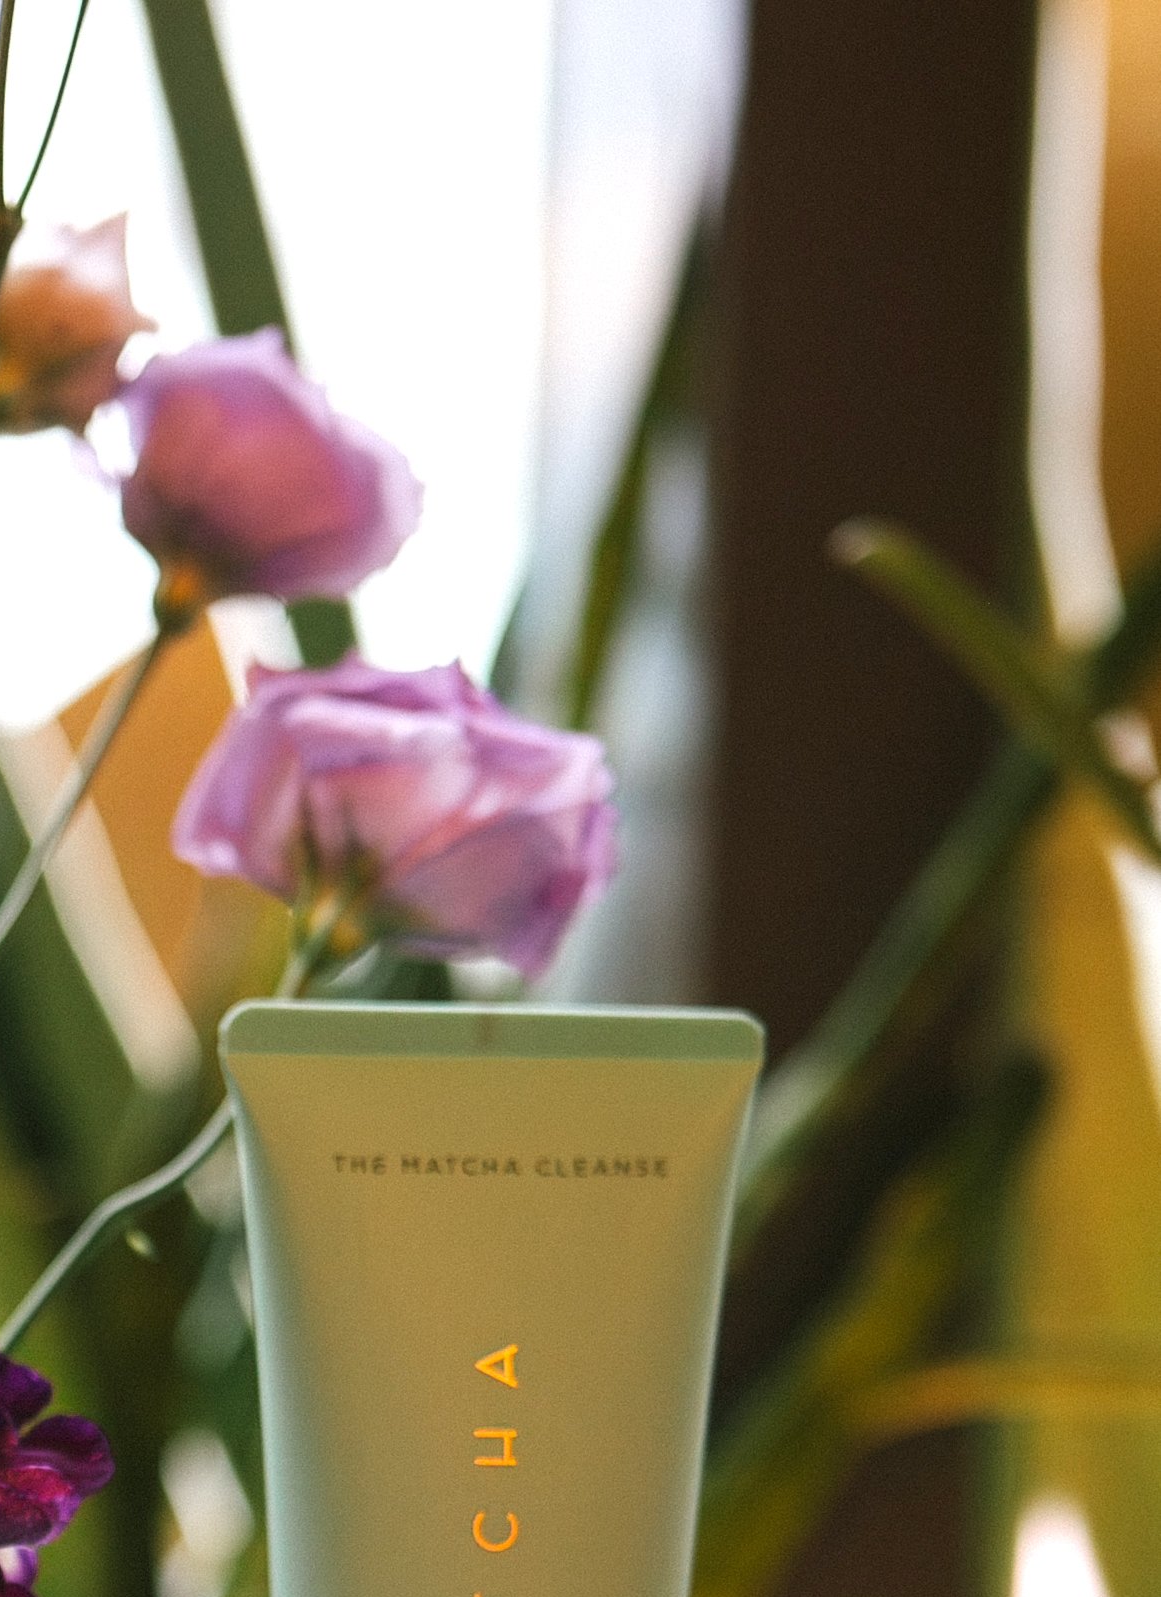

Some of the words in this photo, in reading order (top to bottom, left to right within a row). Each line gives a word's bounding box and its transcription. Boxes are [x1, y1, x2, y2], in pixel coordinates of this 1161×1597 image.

[332, 1154, 388, 1176] THE
[399, 1155, 521, 1177] MATCHA
[534, 1156, 669, 1179] CLEANSE
